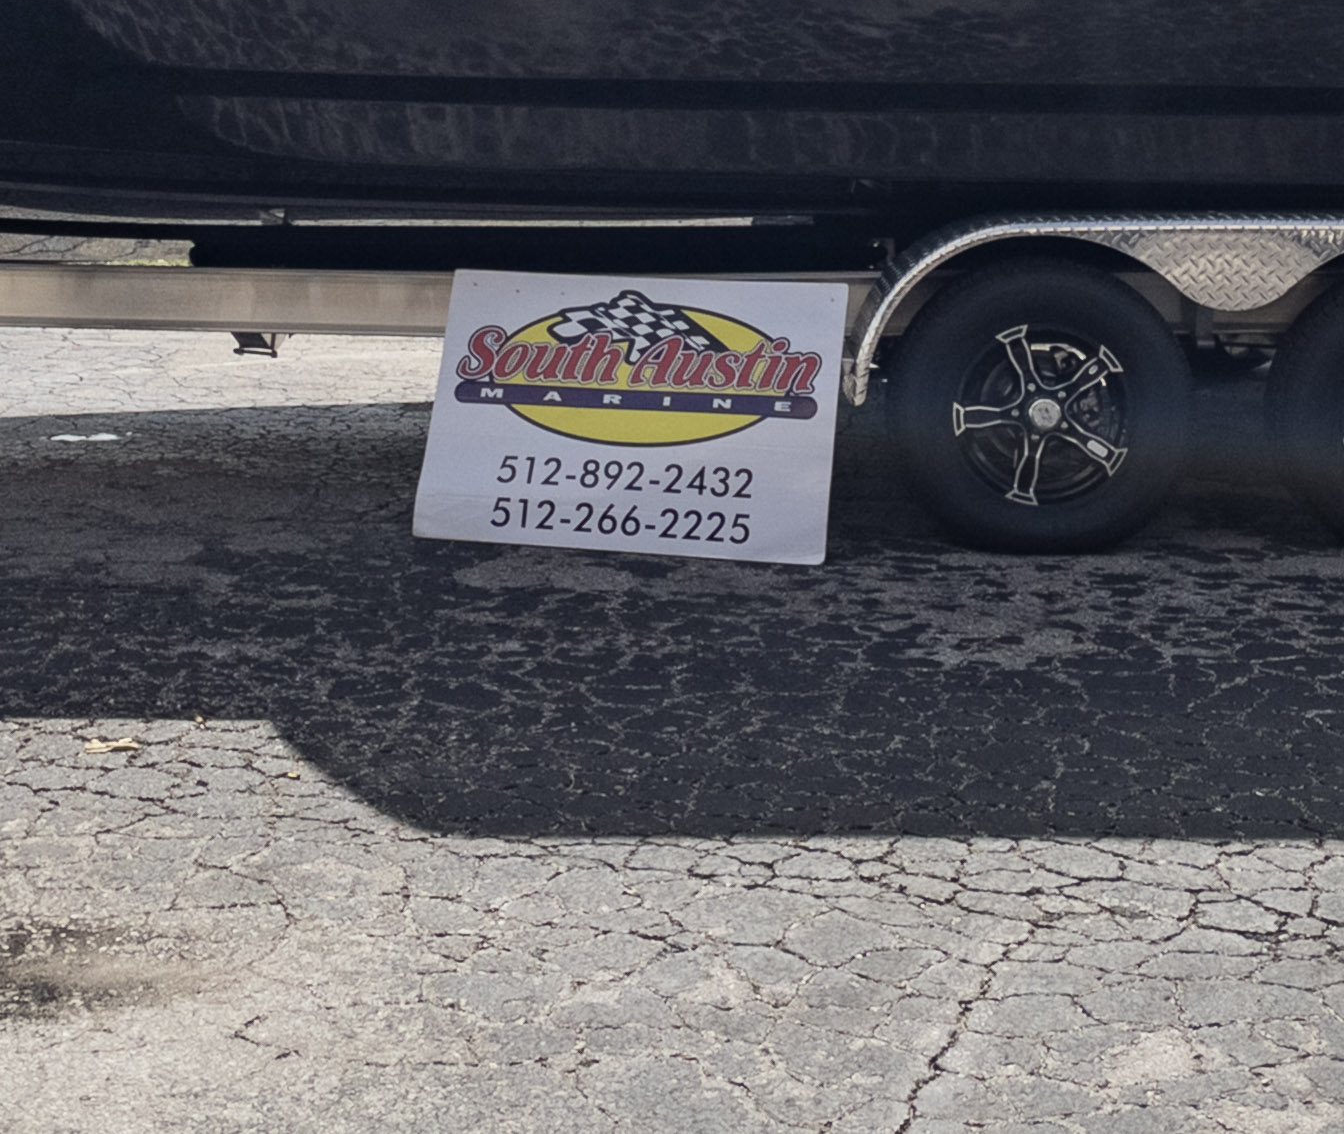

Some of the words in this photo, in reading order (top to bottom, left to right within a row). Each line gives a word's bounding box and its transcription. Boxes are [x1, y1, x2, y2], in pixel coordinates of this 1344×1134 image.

[458, 326, 621, 386] South
[629, 333, 822, 395] Austin
[479, 387, 792, 413] MARINE
[496, 455, 754, 499] 512-892-2432
[490, 497, 751, 544] 512-266-2225
